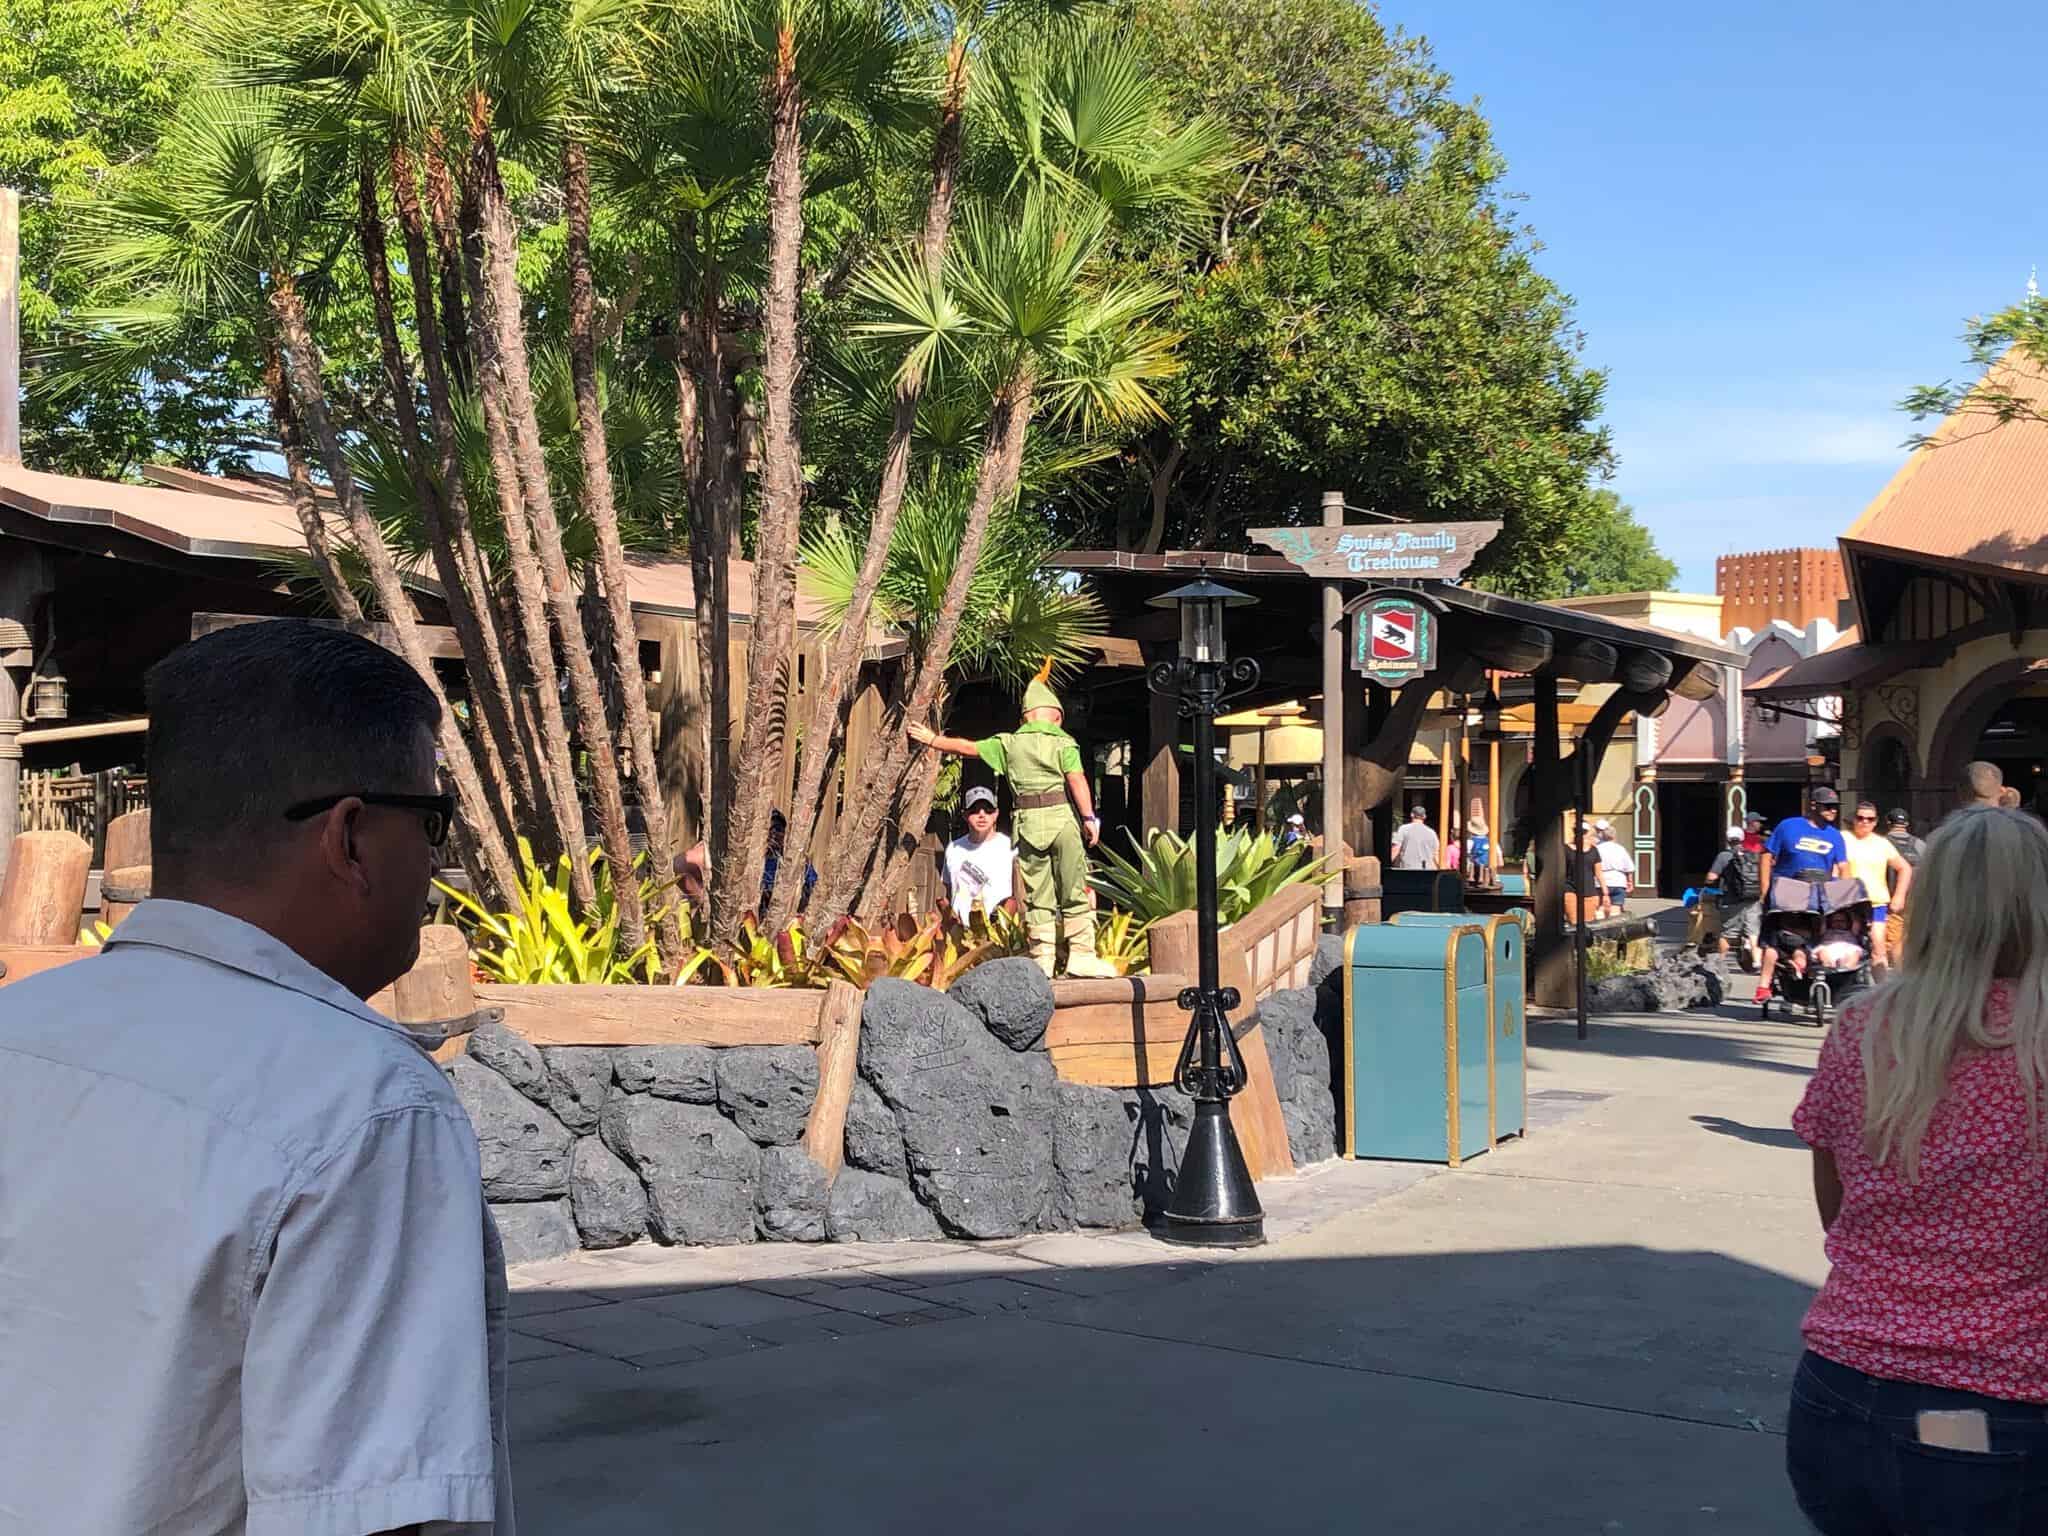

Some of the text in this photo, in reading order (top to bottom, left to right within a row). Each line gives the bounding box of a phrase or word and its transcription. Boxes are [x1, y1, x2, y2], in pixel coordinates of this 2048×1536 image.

[1334, 528, 1457, 553] Swiss Family
[1345, 551, 1440, 572] Treehouse
